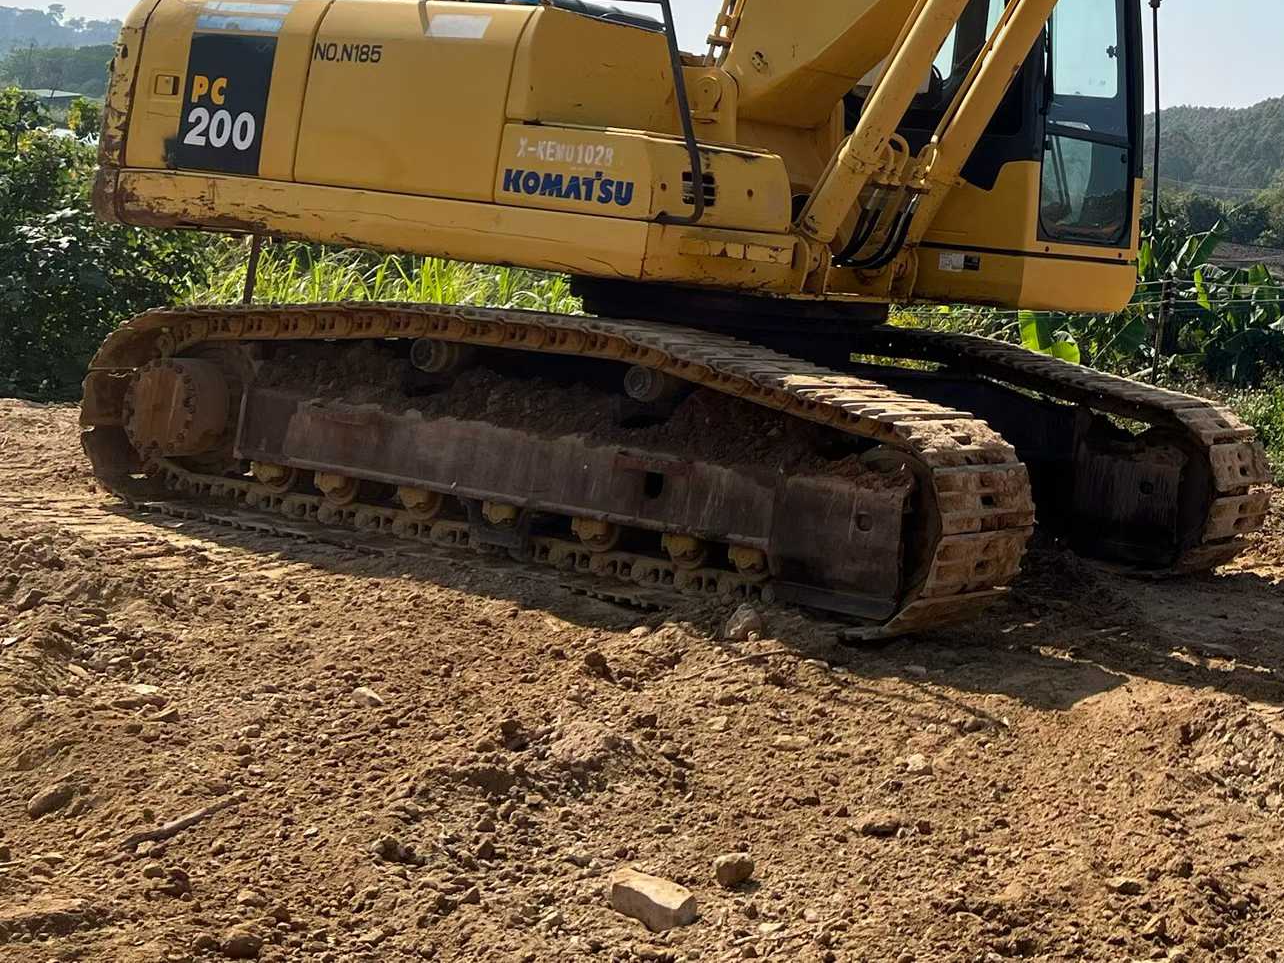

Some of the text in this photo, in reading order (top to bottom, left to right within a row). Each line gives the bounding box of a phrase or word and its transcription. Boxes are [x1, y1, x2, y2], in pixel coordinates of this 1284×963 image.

[313, 42, 383, 63] NO.N185
[190, 75, 228, 105] PC
[183, 107, 256, 151] 200
[502, 168, 634, 206] KOMATSU
